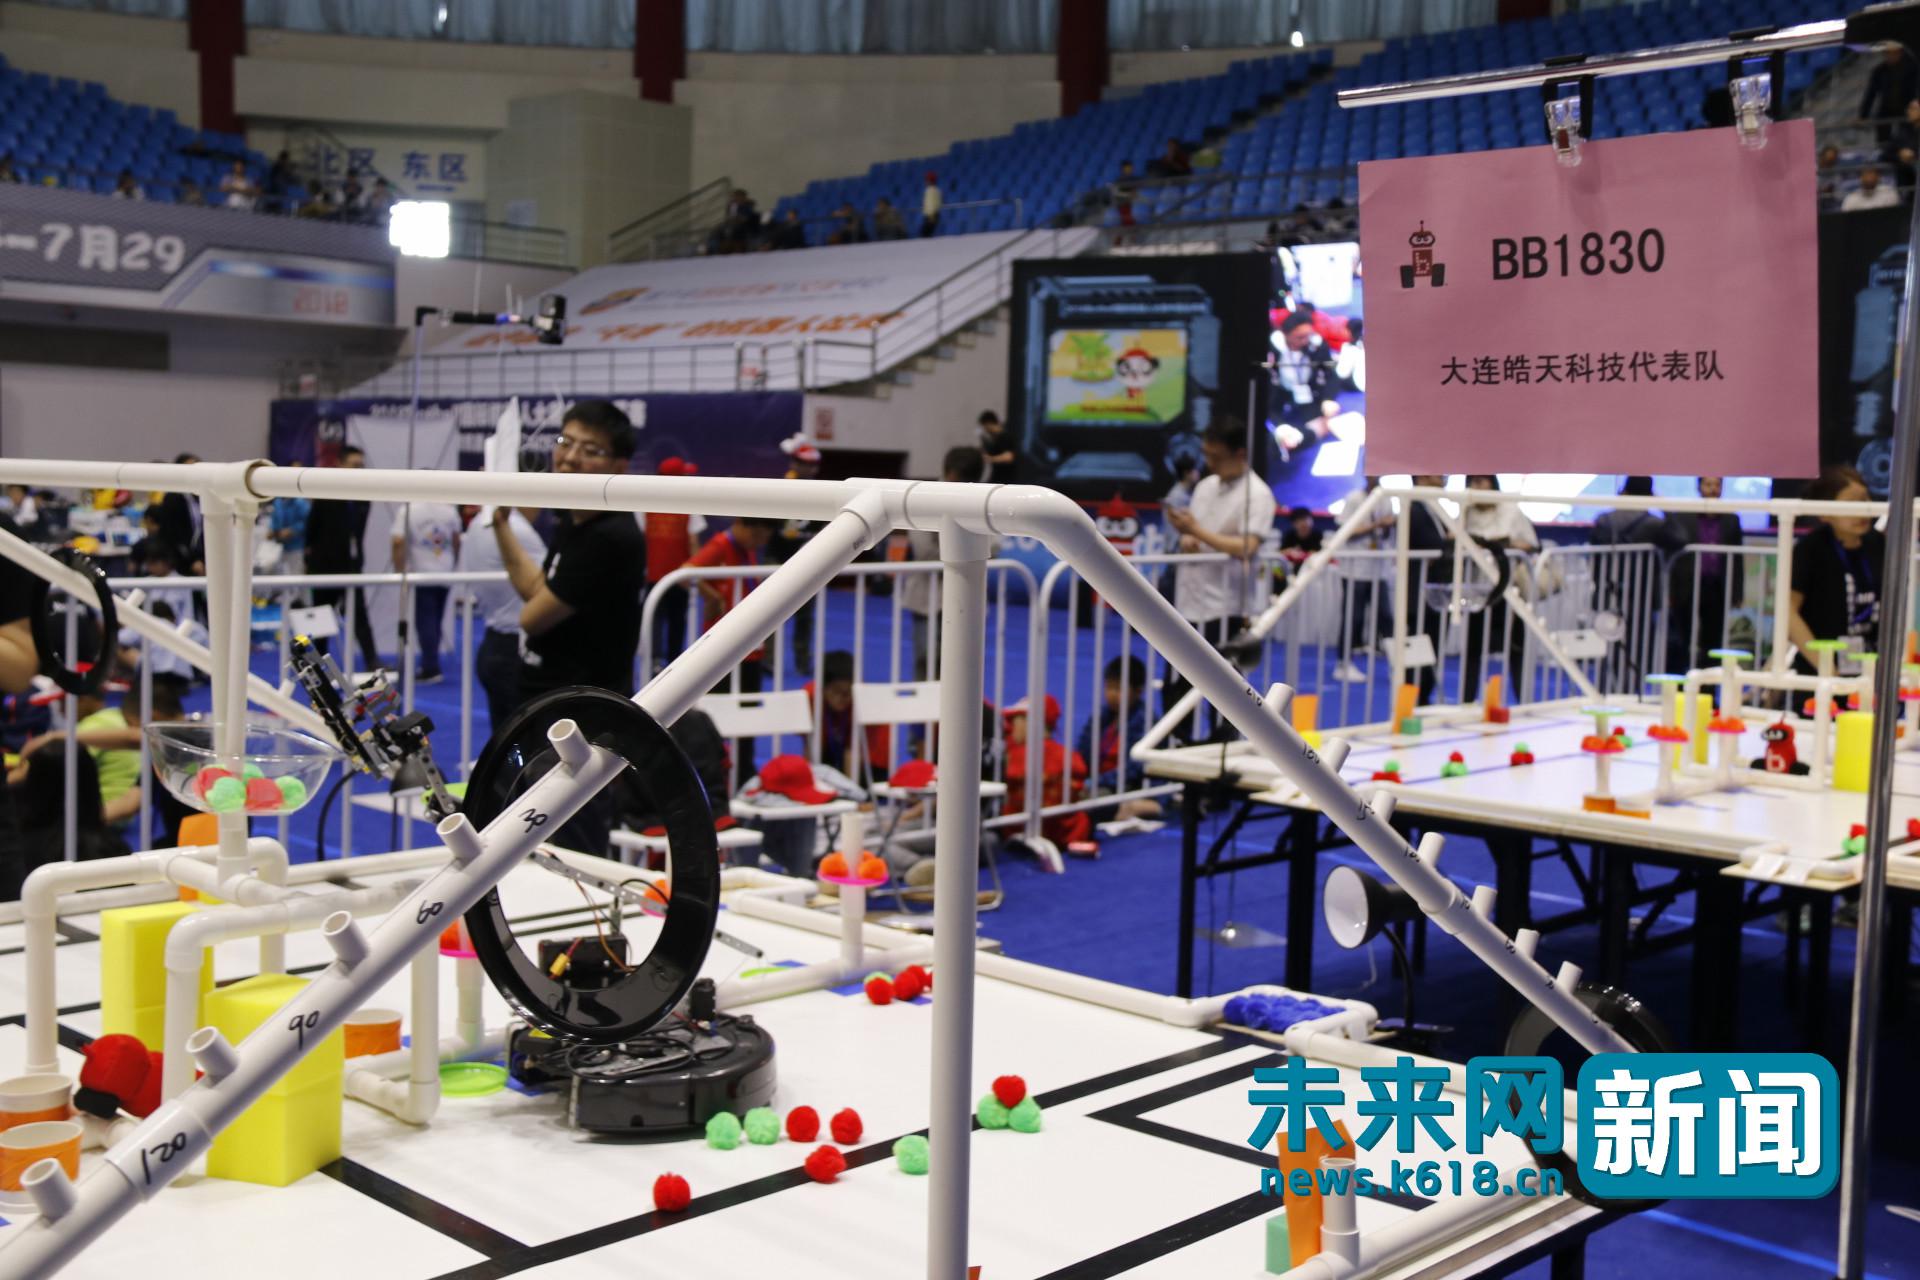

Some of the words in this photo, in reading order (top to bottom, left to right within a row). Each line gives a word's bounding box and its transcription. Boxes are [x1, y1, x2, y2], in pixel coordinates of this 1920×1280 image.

[402, 149, 468, 181] 东区
[0, 222, 187, 275] -7月29
[1491, 227, 1666, 281] BB1830
[1440, 349, 1725, 387] 大连皓天科技代表队
[415, 899, 444, 925] 60
[287, 1009, 321, 1051] 90
[140, 1131, 187, 1186] 120
